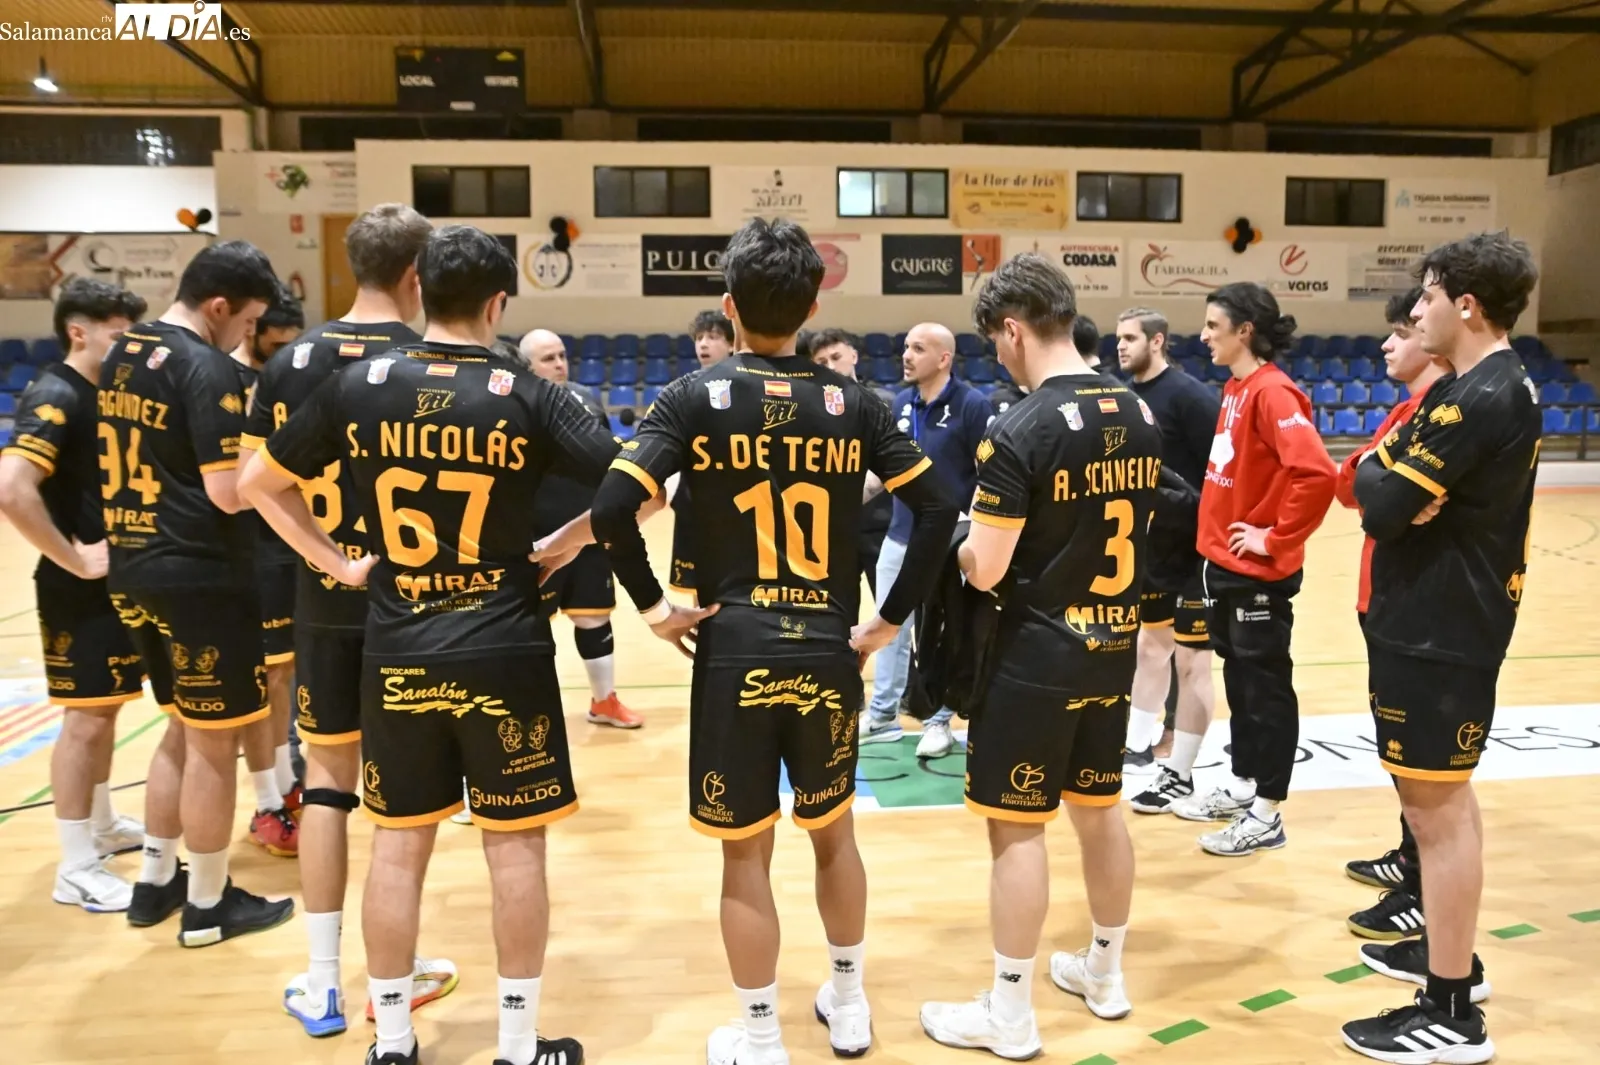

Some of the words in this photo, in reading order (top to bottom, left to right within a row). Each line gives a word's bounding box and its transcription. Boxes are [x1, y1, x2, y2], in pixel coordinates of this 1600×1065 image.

[1063, 253, 1117, 267] CODASA
[735, 366, 774, 377] BALONMANO
[415, 391, 456, 415] Gil
[763, 402, 798, 426] Gil
[346, 422, 369, 457] S.
[380, 419, 529, 471] NICOLÁS
[1103, 426, 1128, 452] Gil
[783, 437, 861, 473] TENA
[1054, 469, 1077, 502] A.
[375, 466, 496, 568] 67
[733, 479, 830, 582] 10
[1089, 499, 1155, 597] 3
[1065, 603, 1140, 635] MiRA
[380, 667, 426, 675] AUTOCARES
[739, 668, 820, 698] Sanalón
[382, 676, 468, 703] Sanalón
[470, 785, 562, 808] GUINALDO
[1001, 798, 1047, 807] FISIOTERAPIA
